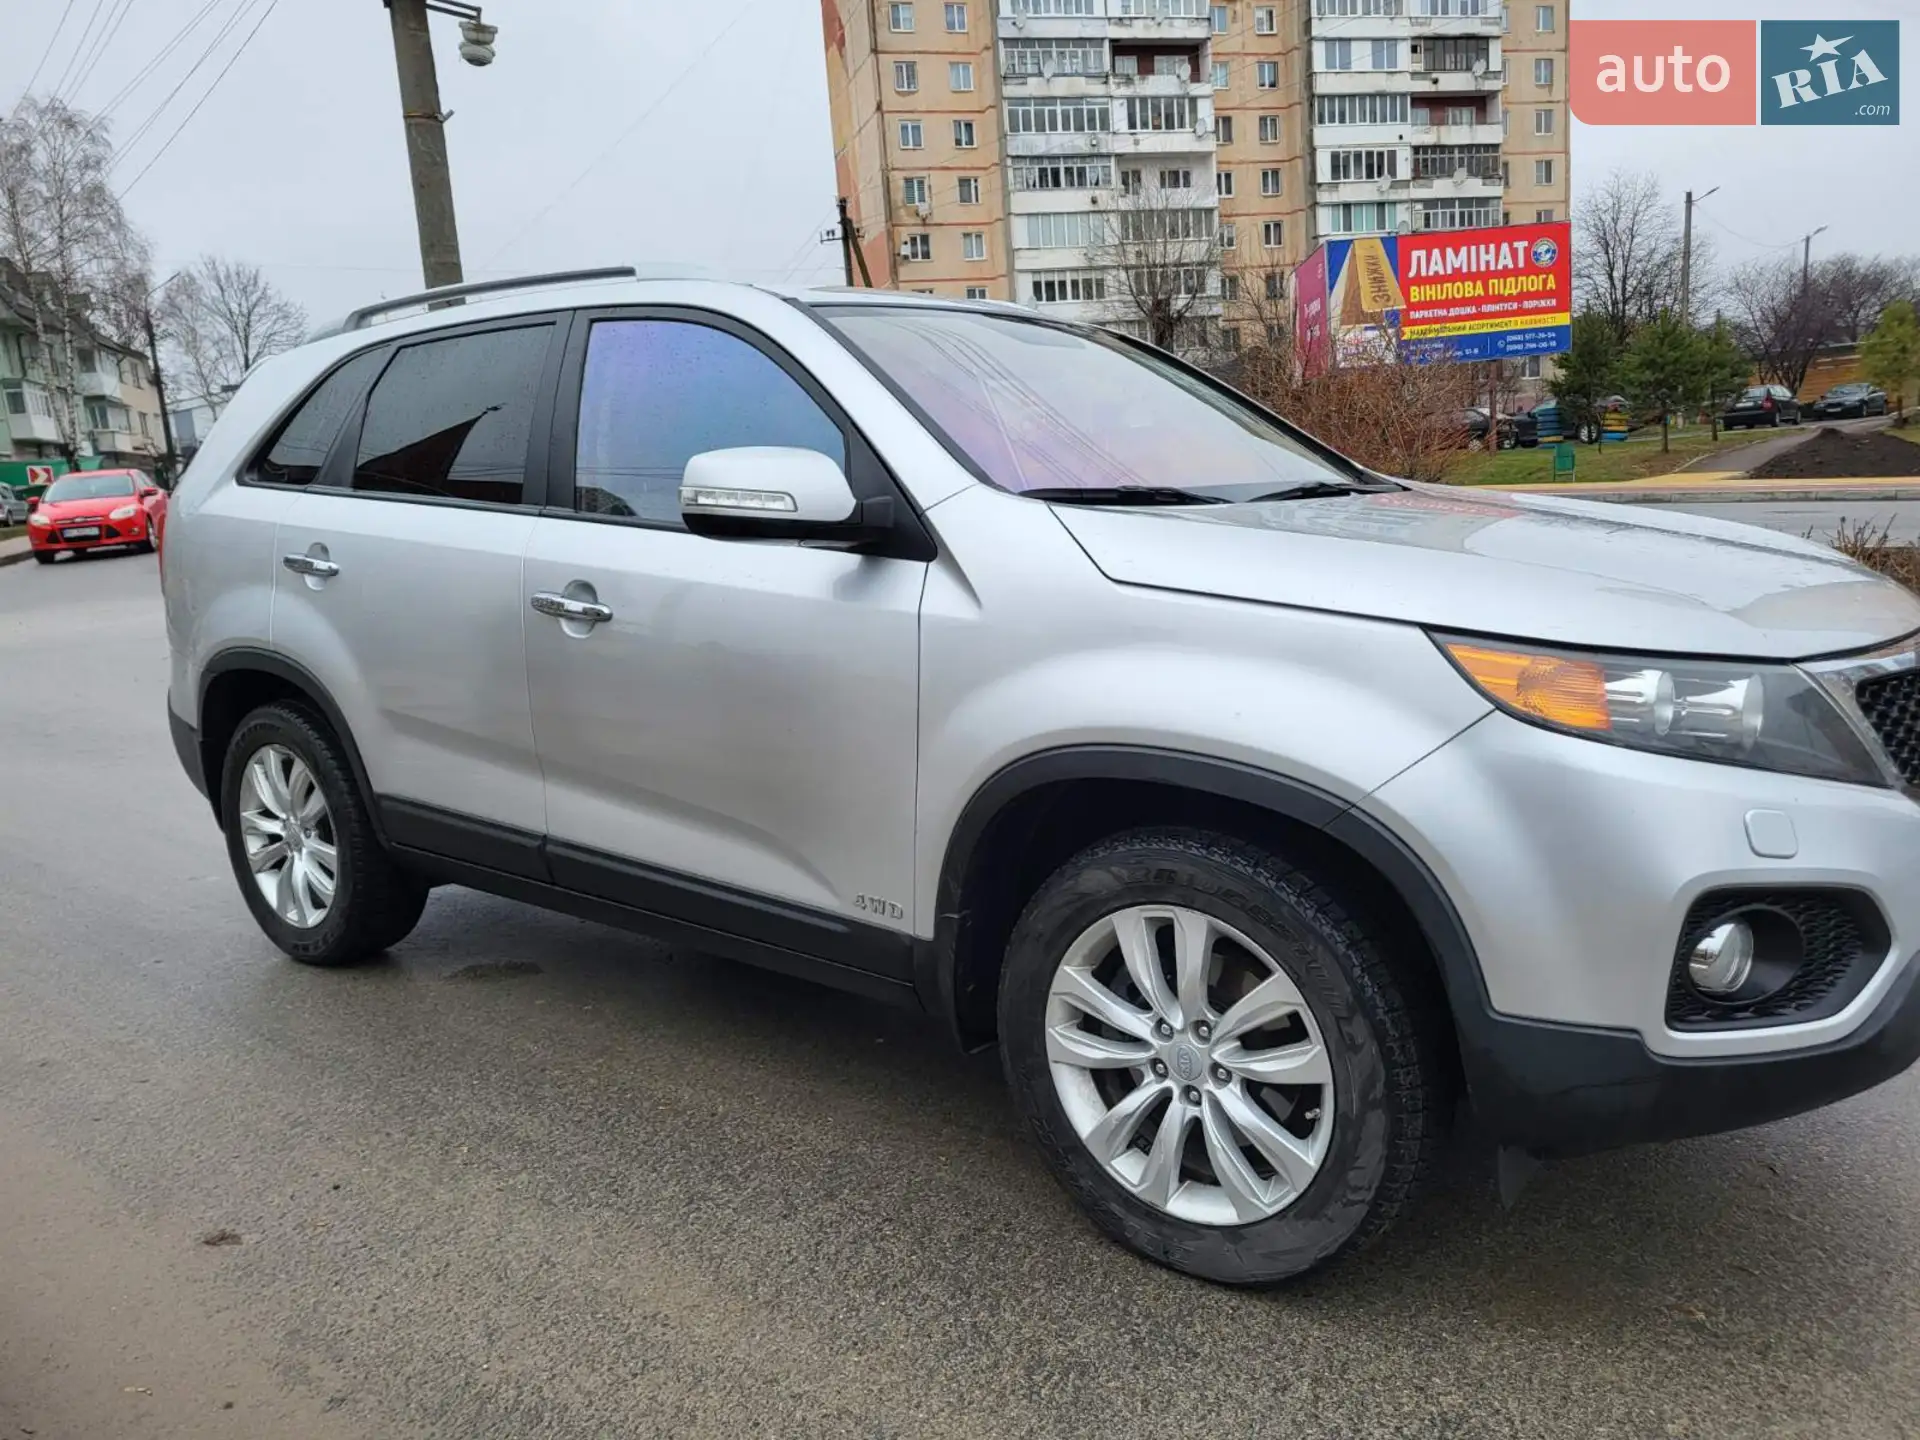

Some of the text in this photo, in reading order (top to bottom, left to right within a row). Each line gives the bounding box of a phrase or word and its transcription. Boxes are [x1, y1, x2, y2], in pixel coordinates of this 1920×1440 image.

[1408, 240, 1528, 278] ЛАМІНАТ
[1409, 273, 1556, 302] ВІНІЛОВА ПІДЛОГА
[1409, 308, 1448, 320] ПАРКЕТНА
[1448, 305, 1477, 317] ДОШКА
[853, 892, 903, 920] 4WD
